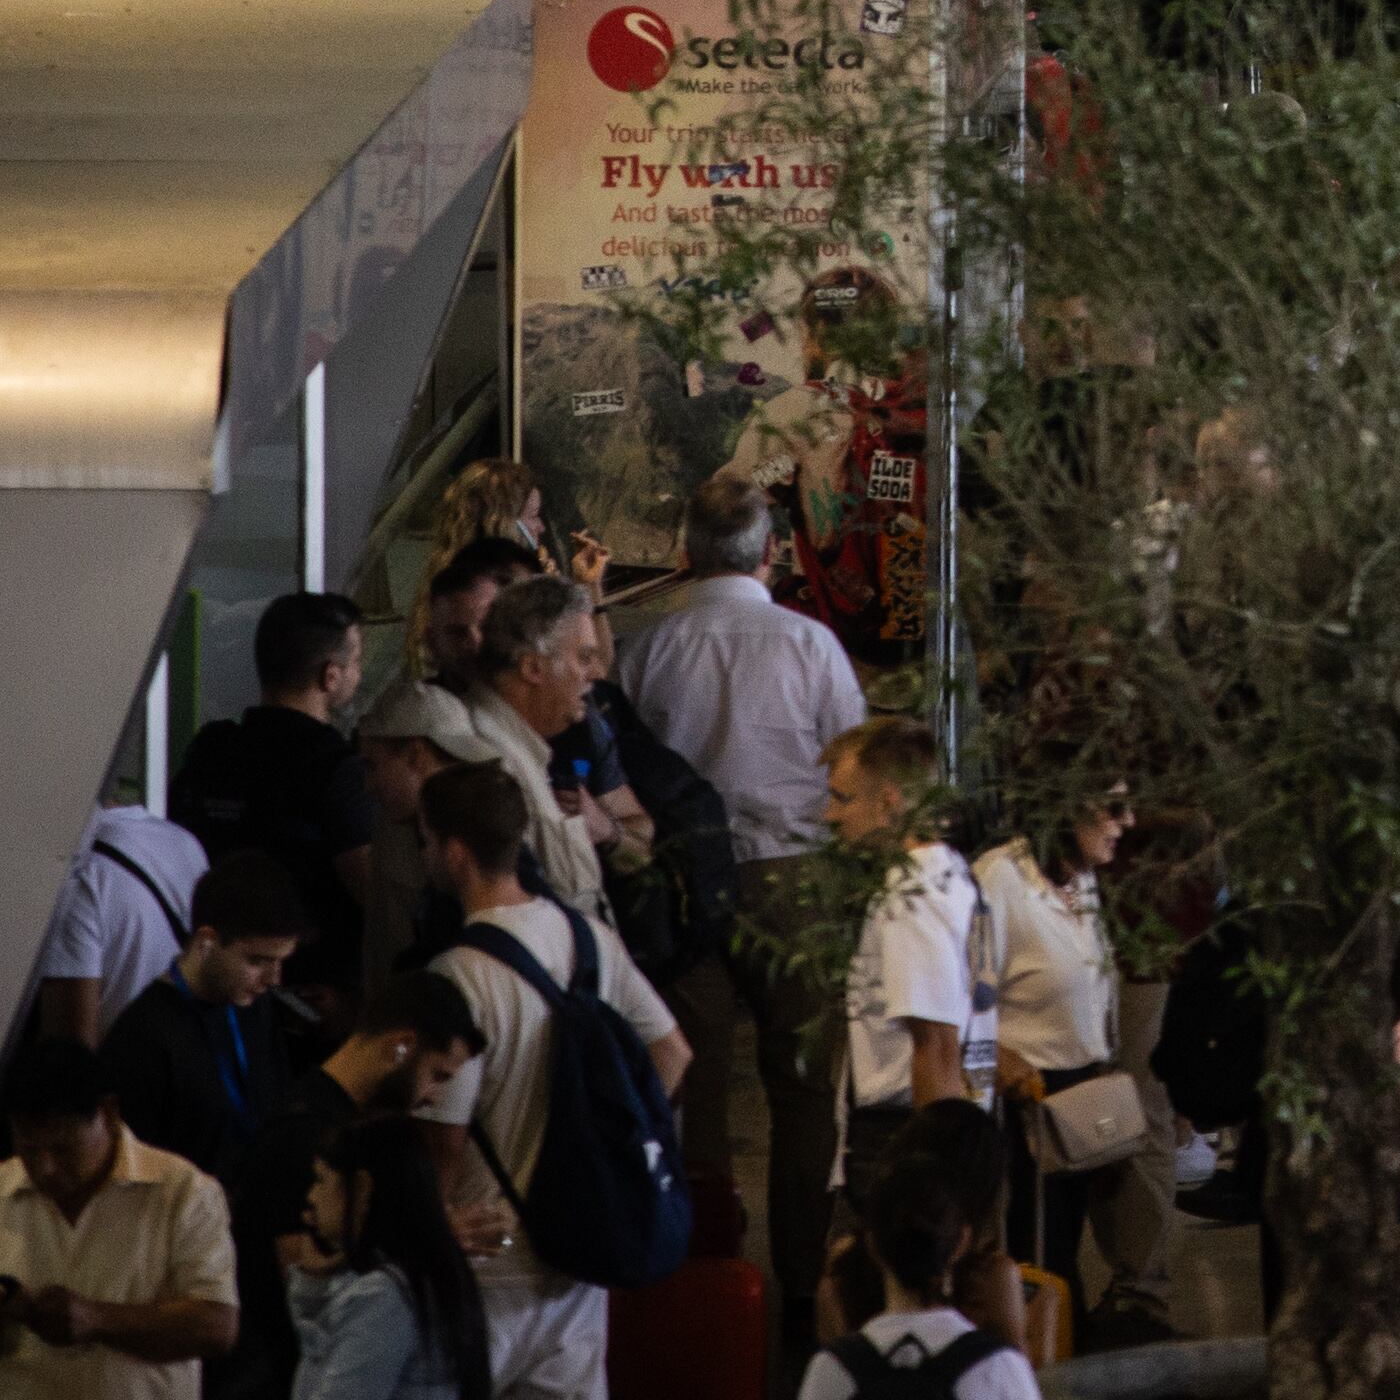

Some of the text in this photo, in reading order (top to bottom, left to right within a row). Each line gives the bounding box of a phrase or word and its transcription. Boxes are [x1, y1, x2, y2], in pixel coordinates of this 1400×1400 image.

[685, 28, 865, 72] selecta
[607, 123, 658, 144] Your
[601, 154, 670, 198] Fly
[612, 203, 657, 223] And
[601, 235, 706, 258] delicious
[873, 456, 912, 478] ILDE
[869, 480, 911, 500] SODA
